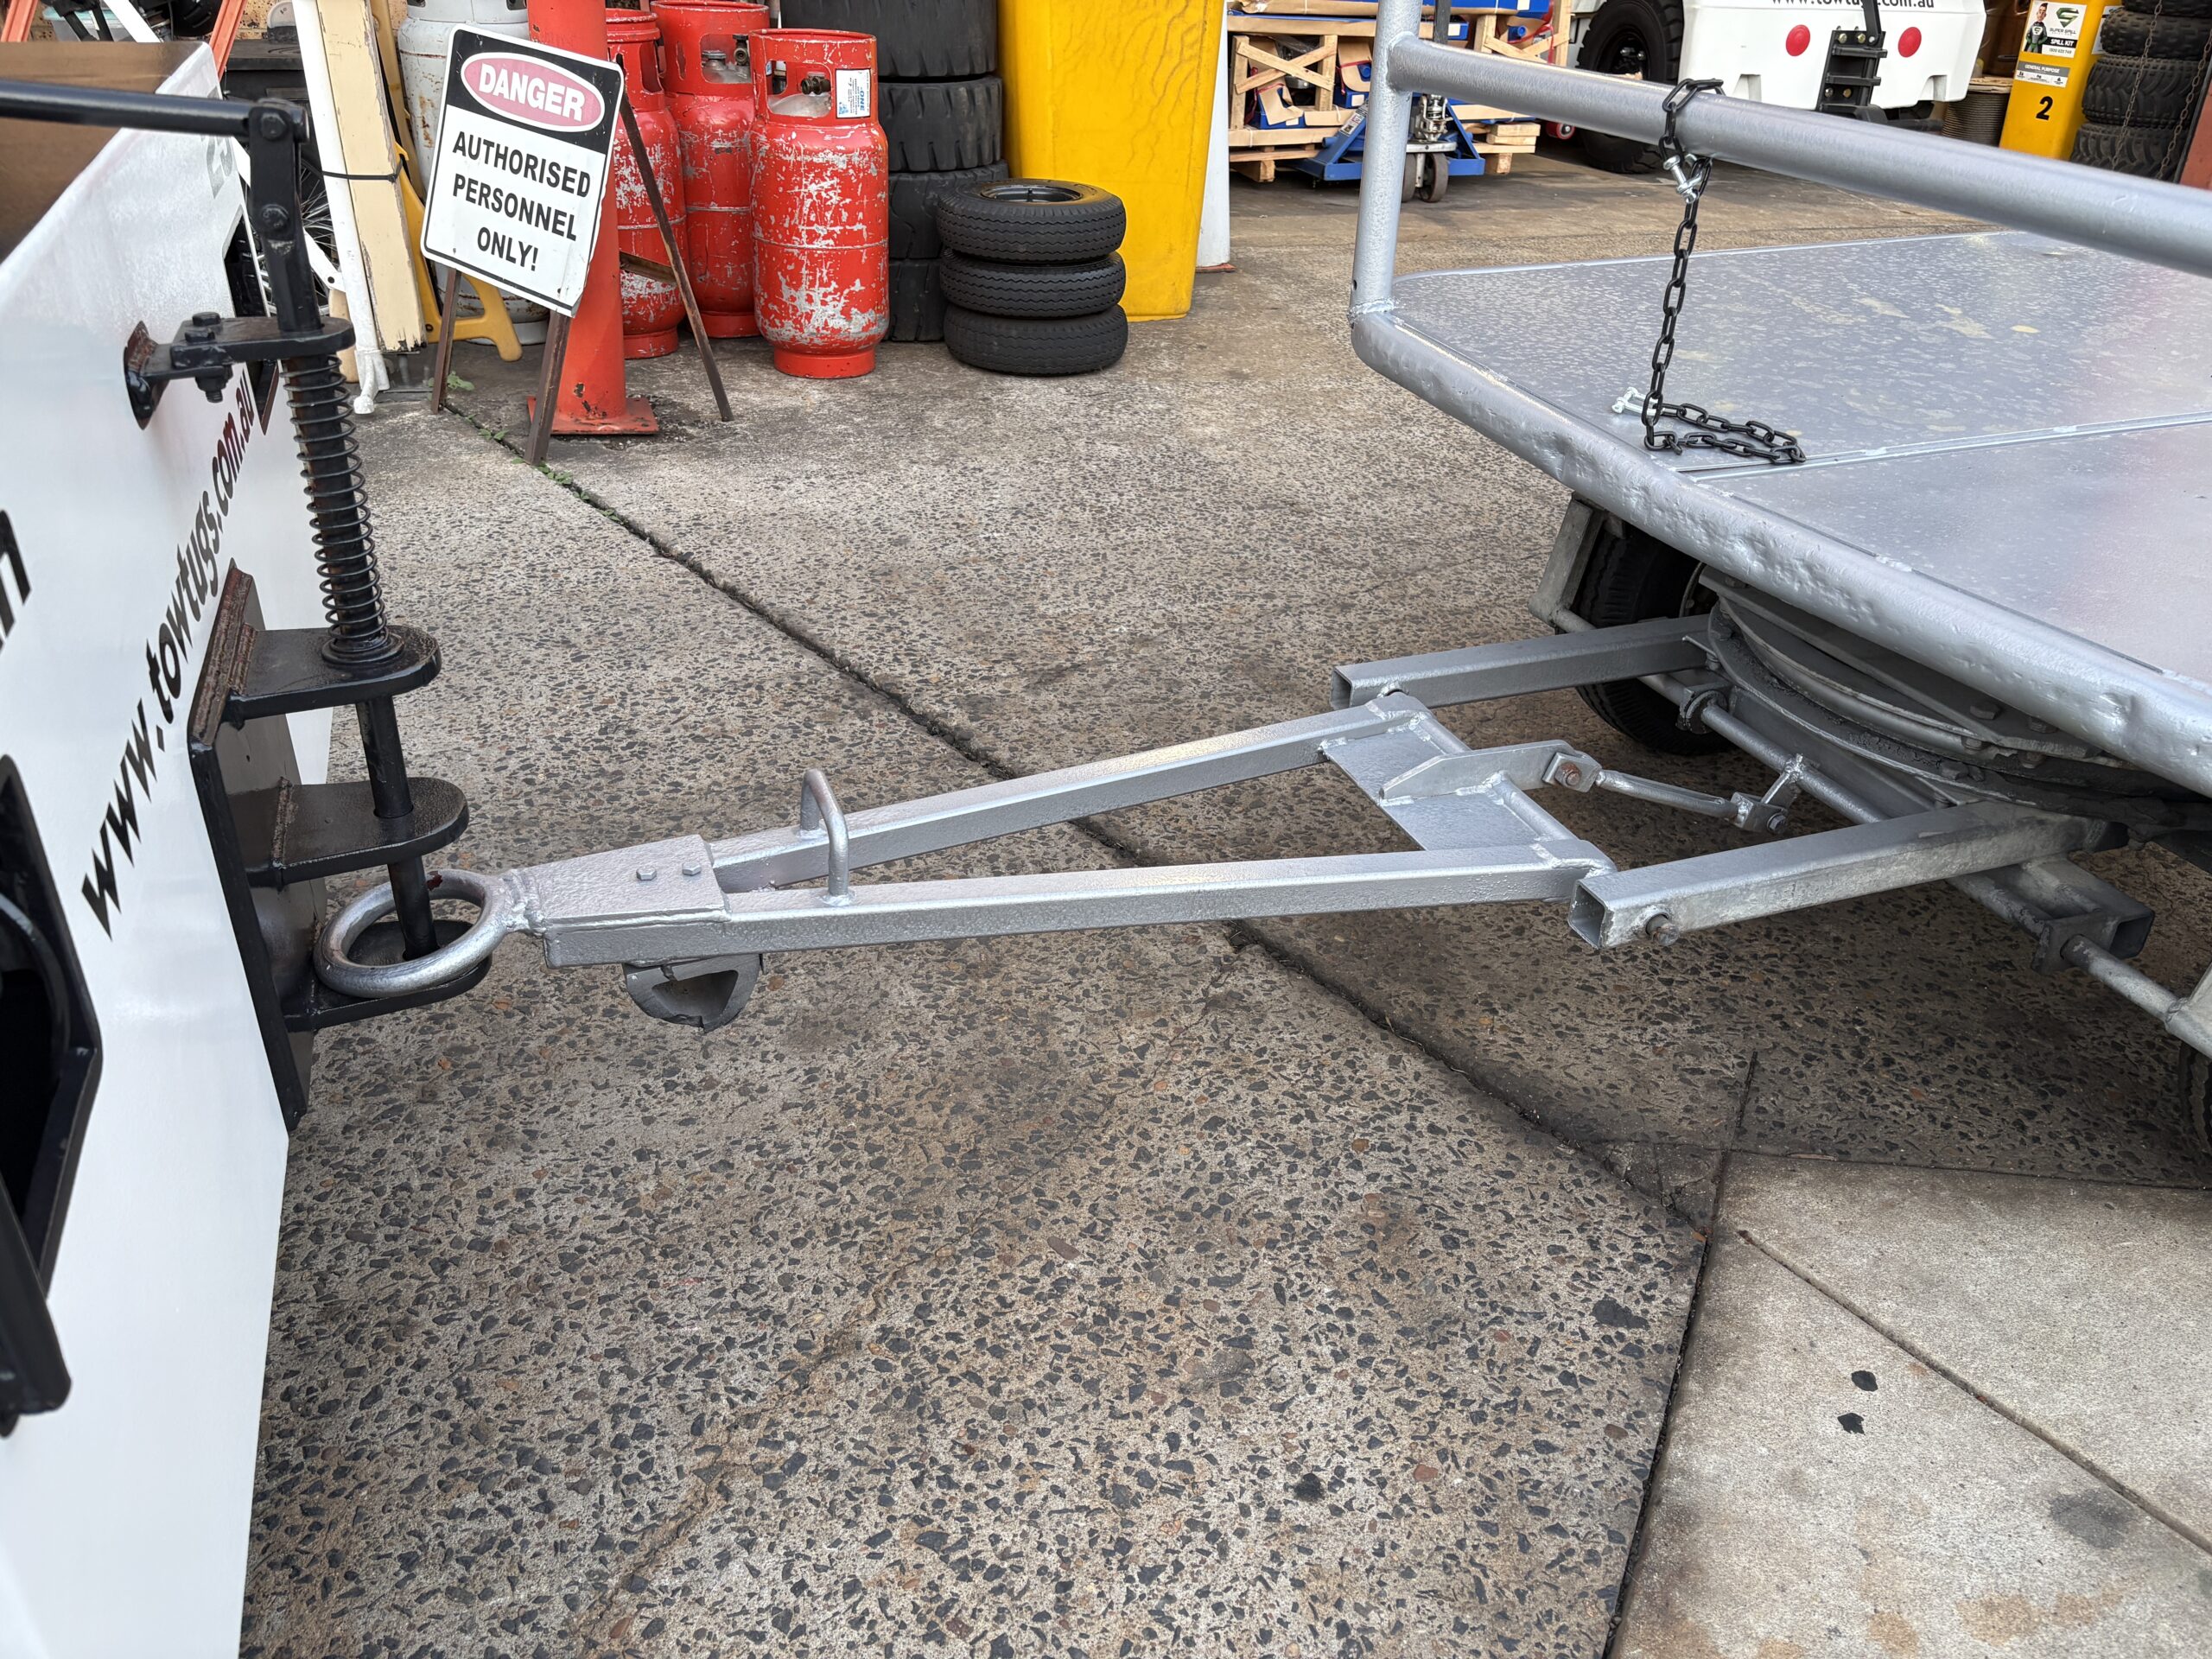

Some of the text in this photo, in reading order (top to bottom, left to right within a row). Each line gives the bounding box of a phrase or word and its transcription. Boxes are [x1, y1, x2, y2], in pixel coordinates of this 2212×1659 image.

[479, 62, 586, 122] DANGER
[2035, 95, 2054, 121] 2
[452, 130, 590, 198] AUTHORISED
[453, 174, 577, 242] PERSONNEL
[477, 226, 539, 271] ONLY!
[81, 368, 255, 942] www.towtugs.com.au
